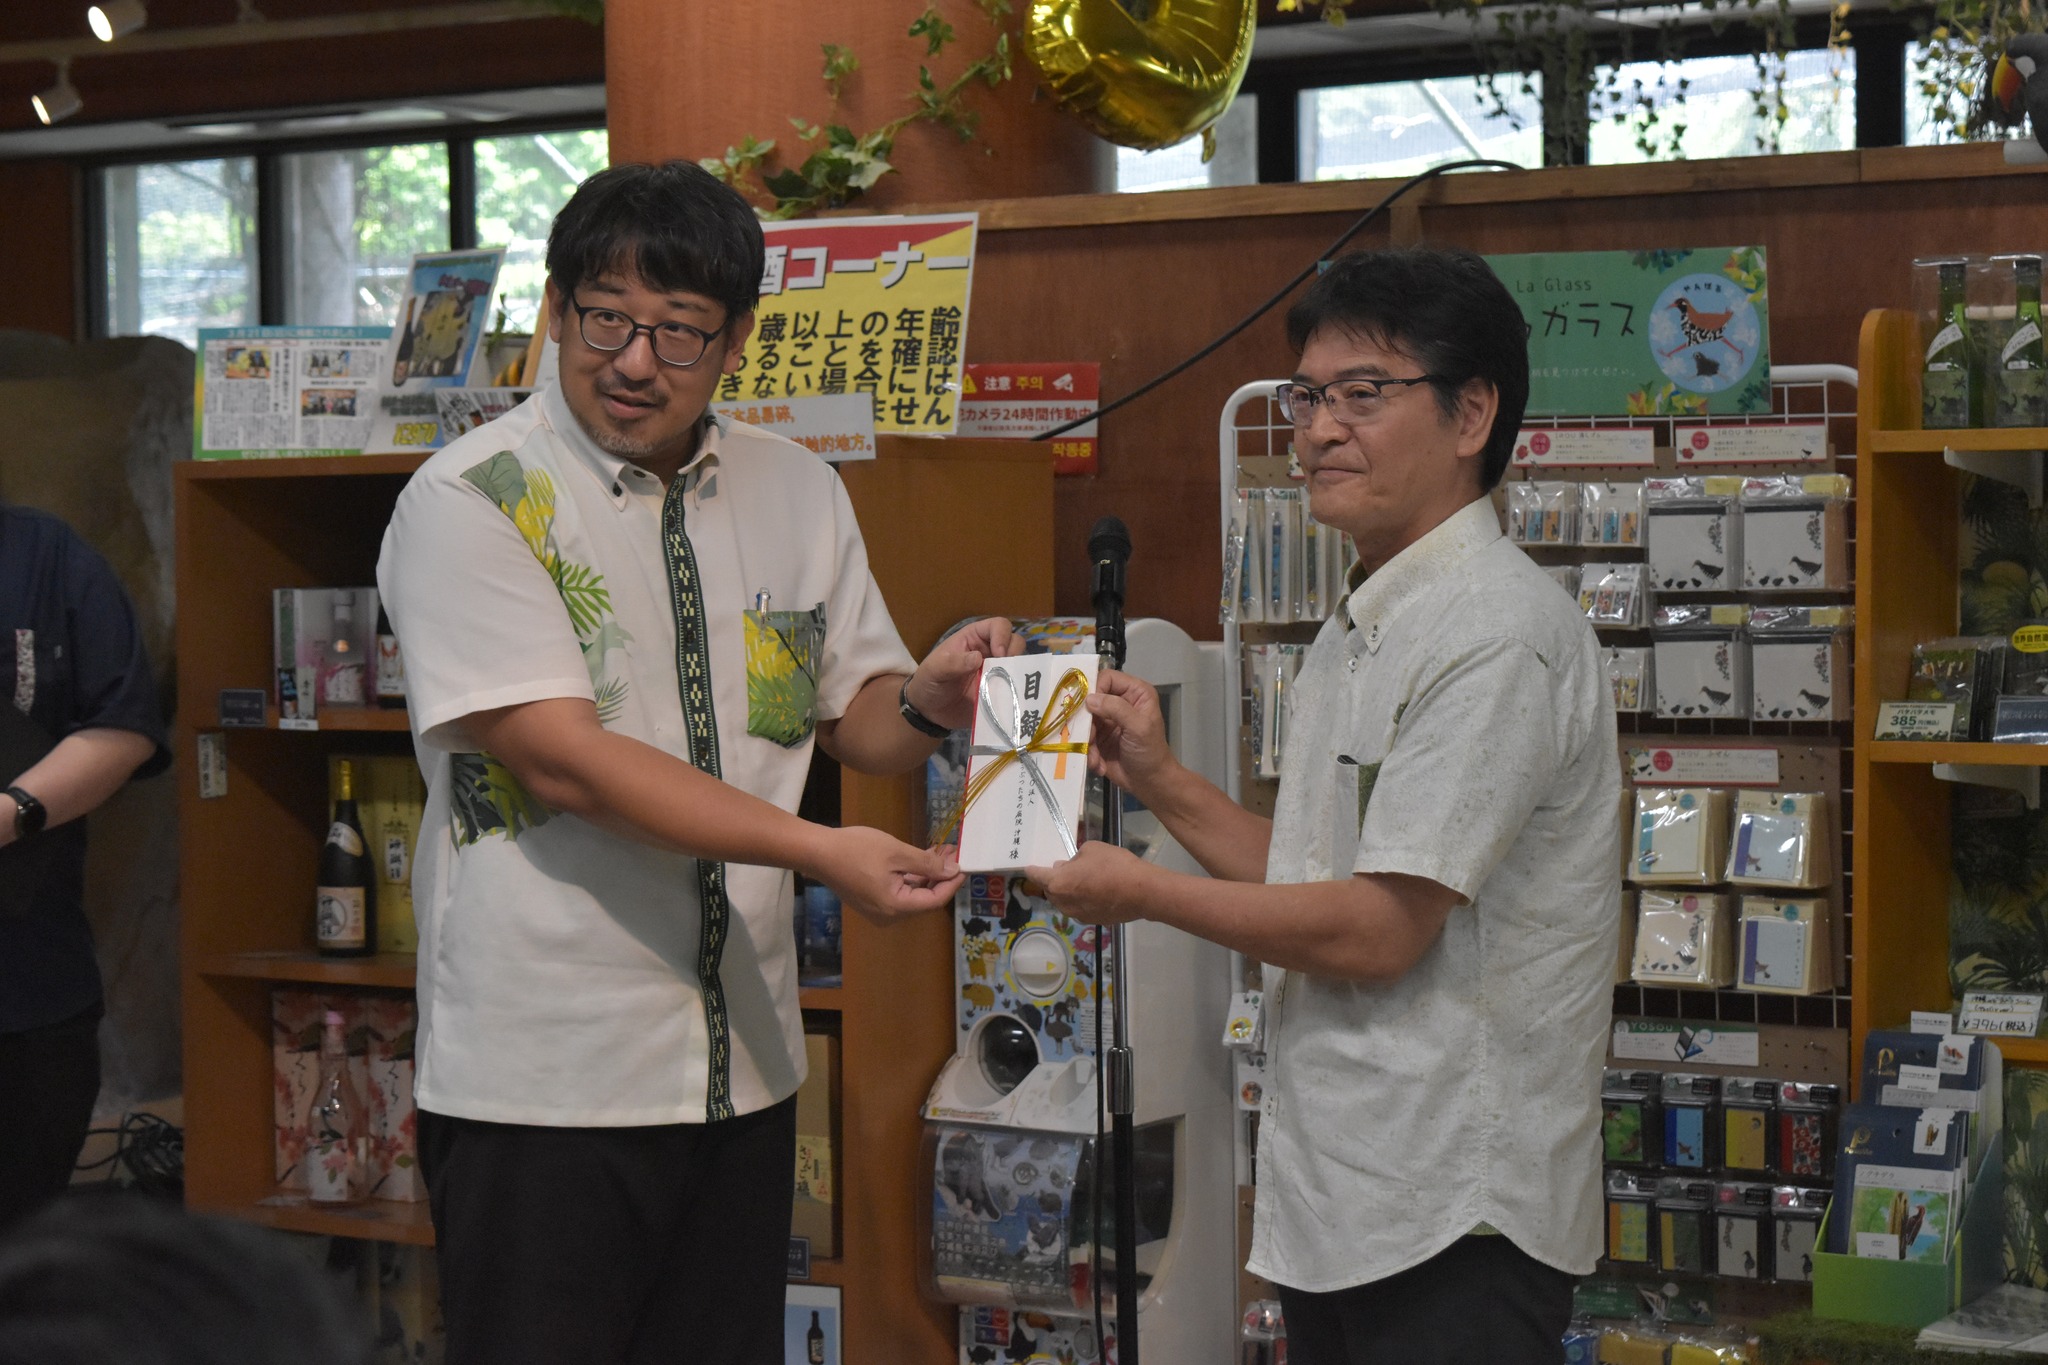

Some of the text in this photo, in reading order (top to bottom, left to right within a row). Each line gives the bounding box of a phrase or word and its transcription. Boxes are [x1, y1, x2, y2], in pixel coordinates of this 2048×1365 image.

[1516, 278, 1593, 293] La Glass
[1682, 282, 1723, 294] やんばる
[757, 305, 962, 343] 歳以上の年齢
[1525, 301, 1635, 338] ガラス
[721, 366, 955, 401] きない場合には
[983, 376, 1012, 391] 注意
[1015, 376, 1044, 390] 주의
[1018, 670, 1042, 740] 目録
[1630, 1022, 1674, 1033] YOSOU
